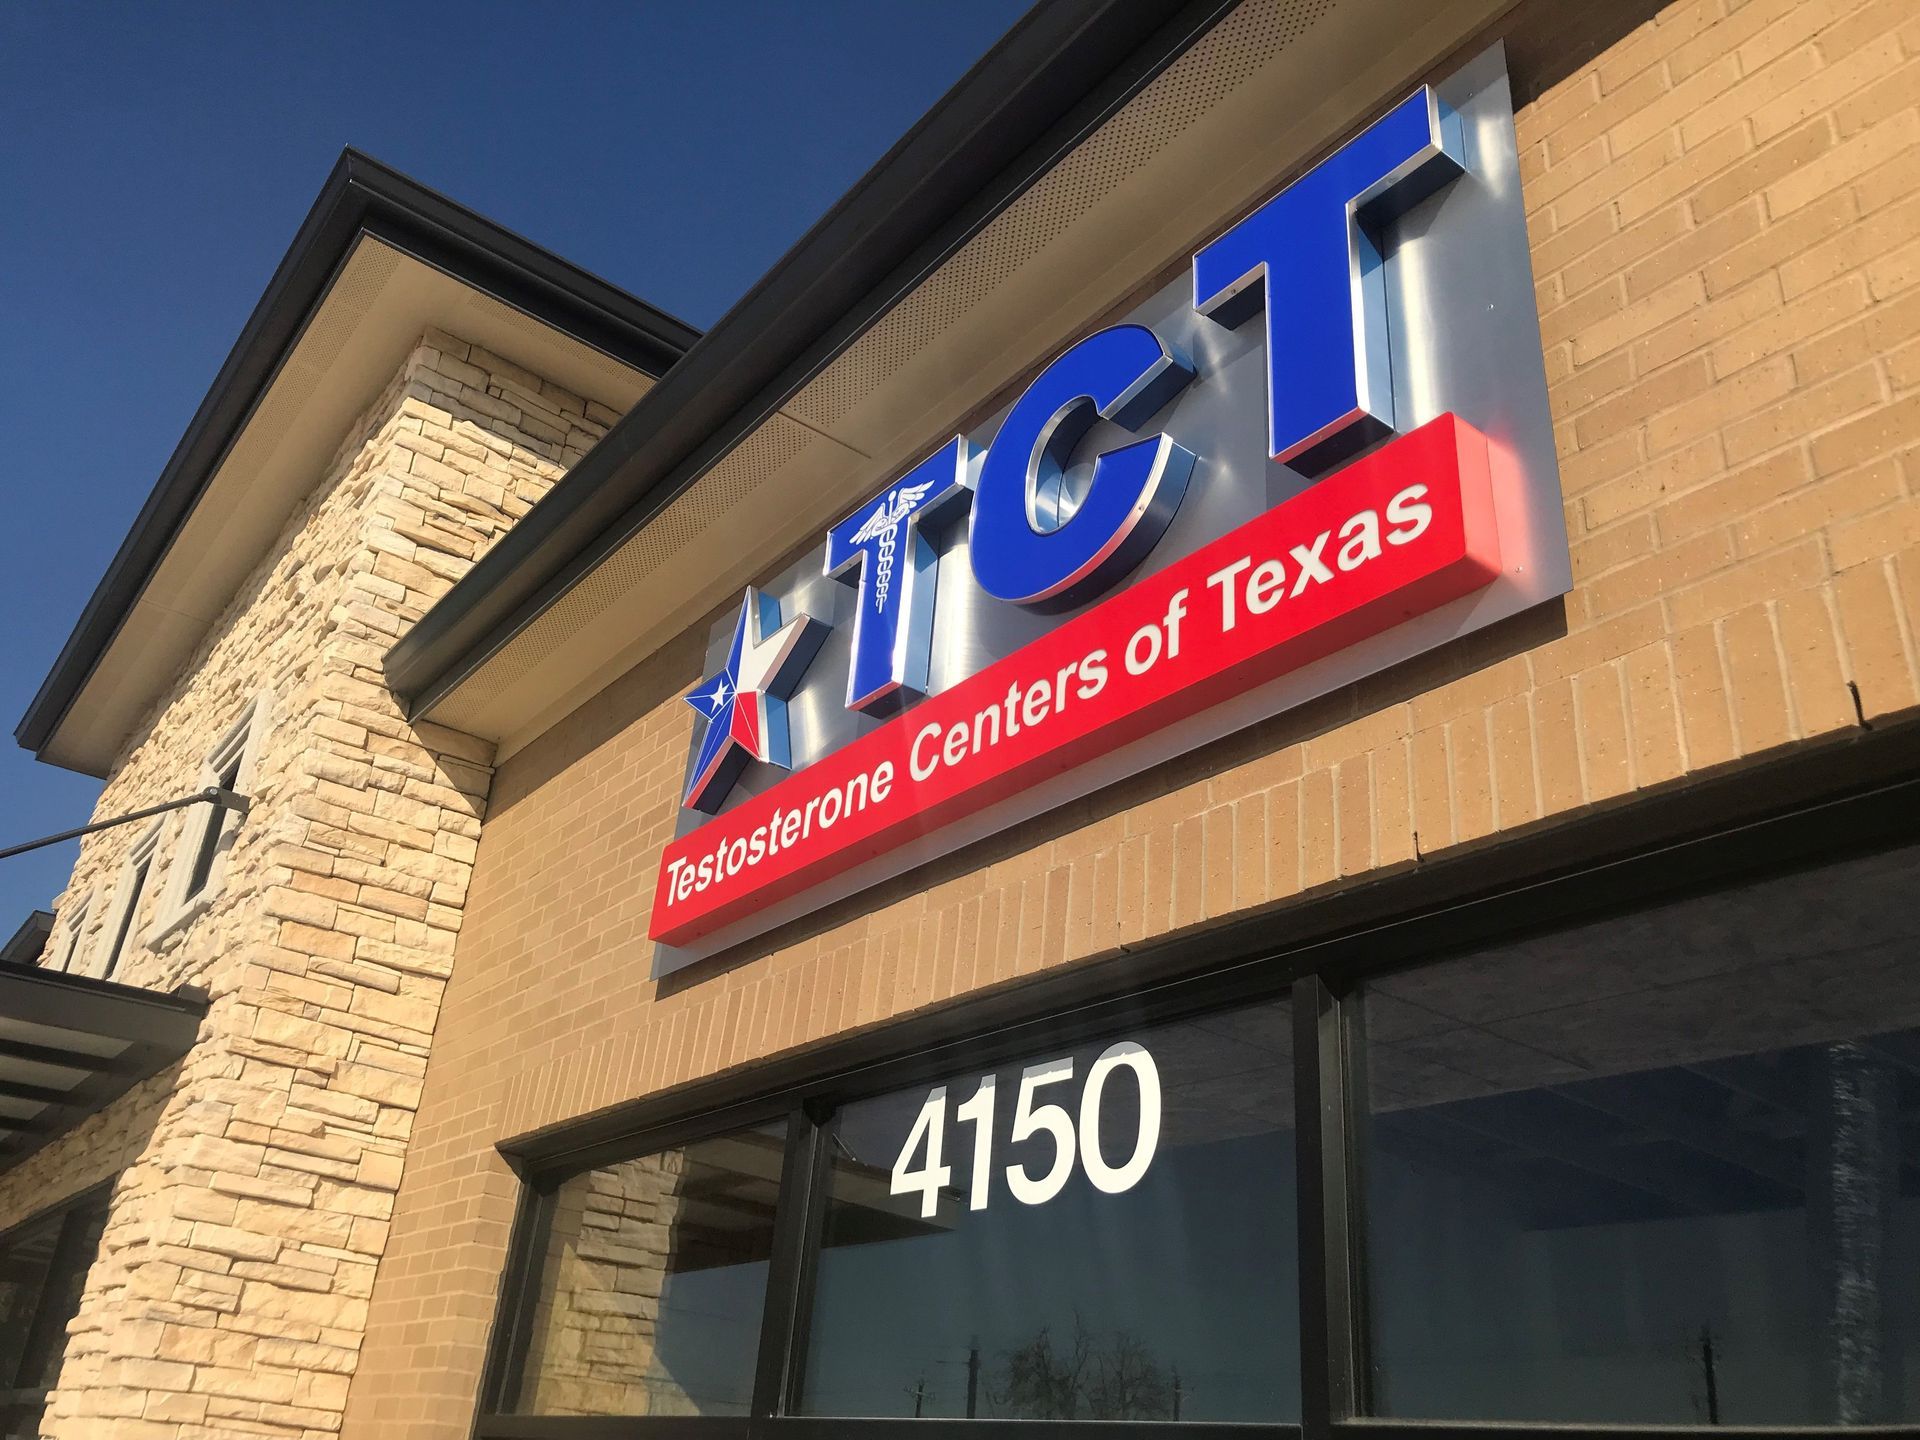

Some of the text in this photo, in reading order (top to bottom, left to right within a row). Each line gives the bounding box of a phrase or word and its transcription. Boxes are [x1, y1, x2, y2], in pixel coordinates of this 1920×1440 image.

[822, 84, 1447, 712] TCT
[666, 483, 1433, 907] Testosterone Centers of Texas
[889, 1041, 1162, 1219] 4150
